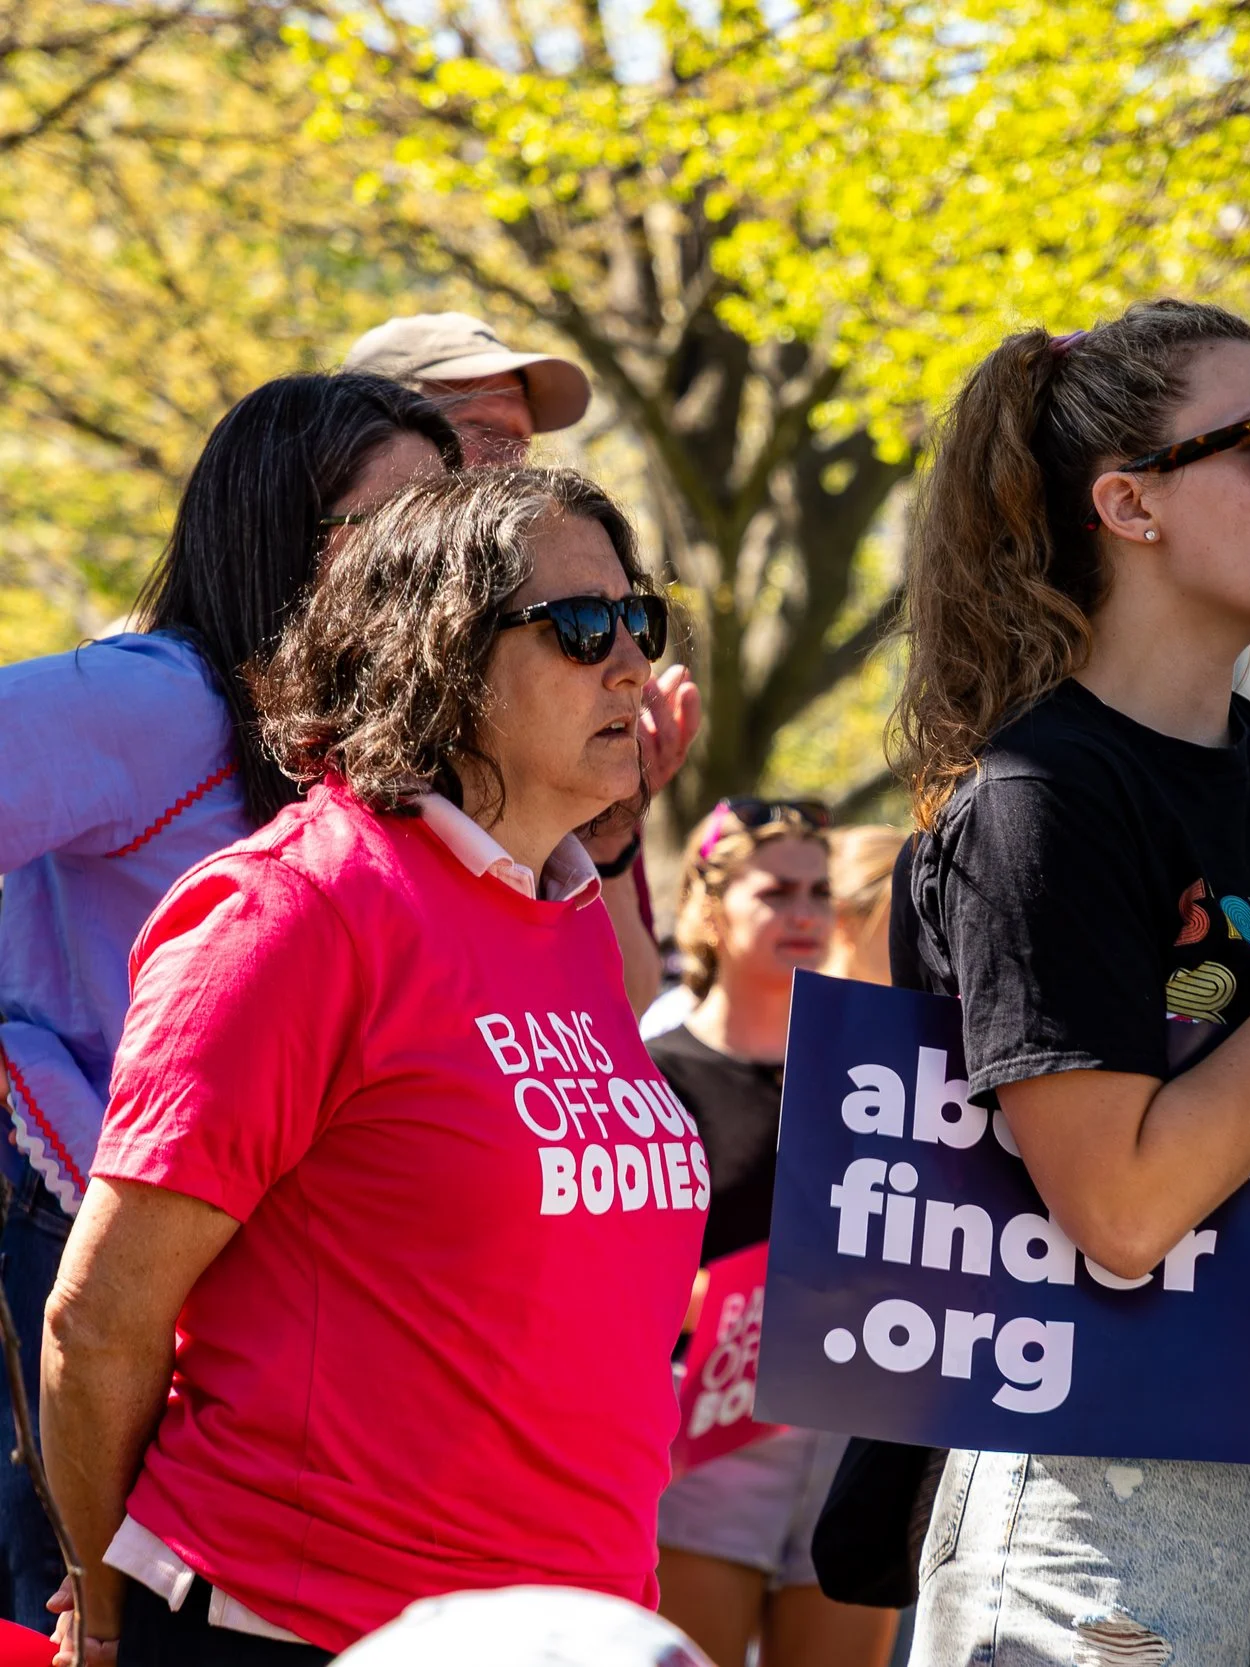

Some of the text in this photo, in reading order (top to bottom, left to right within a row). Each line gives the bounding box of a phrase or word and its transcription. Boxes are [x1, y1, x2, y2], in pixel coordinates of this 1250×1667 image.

[475, 1011, 614, 1075] BANS
[538, 1141, 711, 1216] BODIES
[830, 1157, 1218, 1292] findr
[824, 1299, 1075, 1414] .org
